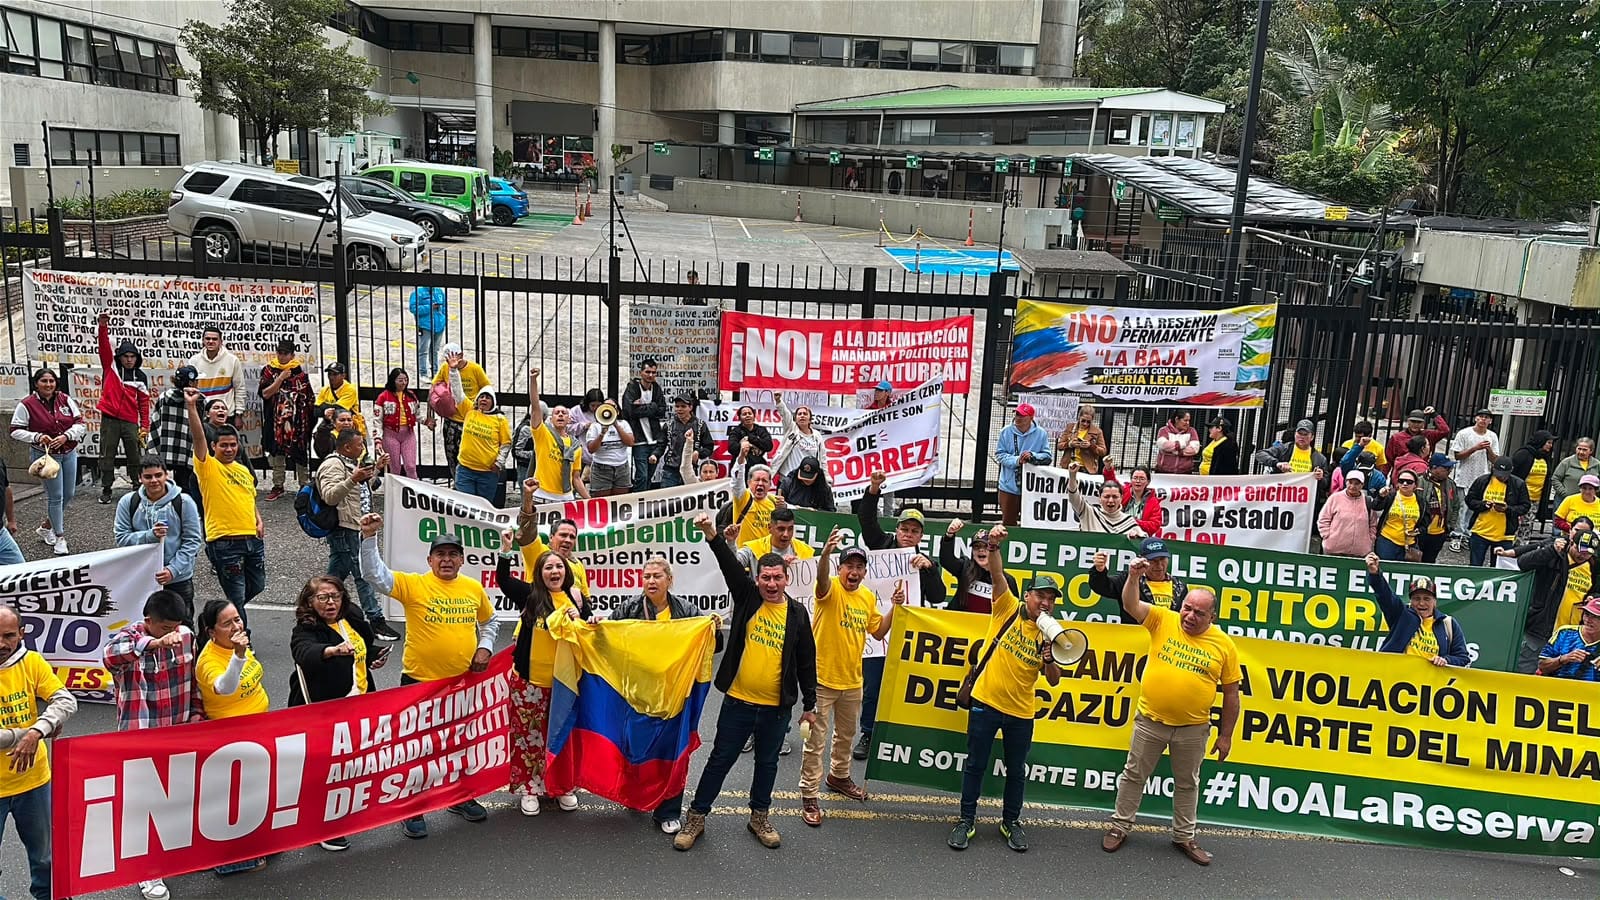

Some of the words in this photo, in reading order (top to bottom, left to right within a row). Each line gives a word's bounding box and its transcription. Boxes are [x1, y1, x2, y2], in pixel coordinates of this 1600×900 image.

[1122, 316, 1132, 329] A
[1136, 316, 1153, 329] LA
[1157, 314, 1218, 329] RESERVA
[833, 331, 844, 347] A
[850, 331, 864, 347] LA
[867, 326, 968, 348] DELIMITACIÓN
[1119, 328, 1215, 344] PERMANENTE
[729, 327, 823, 383] ¡NO!
[831, 349, 887, 362] AMAÑADA
[889, 351, 896, 361] Y
[898, 346, 969, 361] POLITIQUERA
[832, 364, 855, 384] DE
[859, 359, 967, 384] SANTURBÁN
[1092, 373, 1147, 385] MINERÍA
[1149, 374, 1191, 386] LEGAL
[1103, 367, 1120, 375] QUE
[1122, 367, 1149, 375] ACABA
[1151, 367, 1170, 375] CON
[1170, 367, 1181, 375] LA
[918, 383, 943, 400] (ZRP)
[1101, 386, 1115, 395] DE
[1116, 386, 1141, 396] SOTO
[1143, 386, 1179, 396] NORTE!
[708, 410, 729, 423] LAS
[732, 409, 783, 424] ZNAS
[811, 414, 849, 428] ESERVA
[902, 404, 923, 418] SON
[856, 434, 877, 452] DE
[1025, 472, 1054, 494] Una
[1170, 486, 1209, 503] pasa
[1212, 487, 1240, 504] por
[1244, 483, 1309, 503] encima
[401, 486, 510, 525] Gobierno
[564, 498, 609, 530] NO
[611, 500, 633, 523] le
[638, 490, 730, 519] importa
[1033, 498, 1068, 523] del
[1176, 504, 1207, 529] de
[1212, 505, 1295, 531] Estado
[418, 516, 447, 543] el
[572, 516, 704, 551] mbiente
[793, 525, 824, 549] EL
[1007, 540, 1047, 566] DE
[1058, 544, 1137, 573] PETR
[1171, 554, 1208, 580] LE
[1218, 557, 1338, 591] QUIERE
[1348, 569, 1517, 604] ETEGAR
[0, 564, 92, 594] UIERE
[1219, 624, 1342, 646] RMADOS
[1157, 651, 1174, 665] CON
[332, 722, 354, 757] A
[360, 713, 393, 750] LA
[398, 671, 511, 738] DELIMITA
[1267, 667, 1497, 724] VIOLACIÓN
[1514, 696, 1600, 737] DEL
[326, 737, 433, 785] AMAÑADA
[440, 730, 454, 750] Y
[453, 704, 510, 746] POLITI
[1241, 710, 1374, 755] PARTE
[1387, 727, 1470, 768] DEL
[877, 741, 911, 765] EN
[918, 748, 968, 773] SOT
[324, 784, 370, 822] DE
[378, 734, 510, 804] SANTUR
[80, 733, 306, 878] ¡NO!
